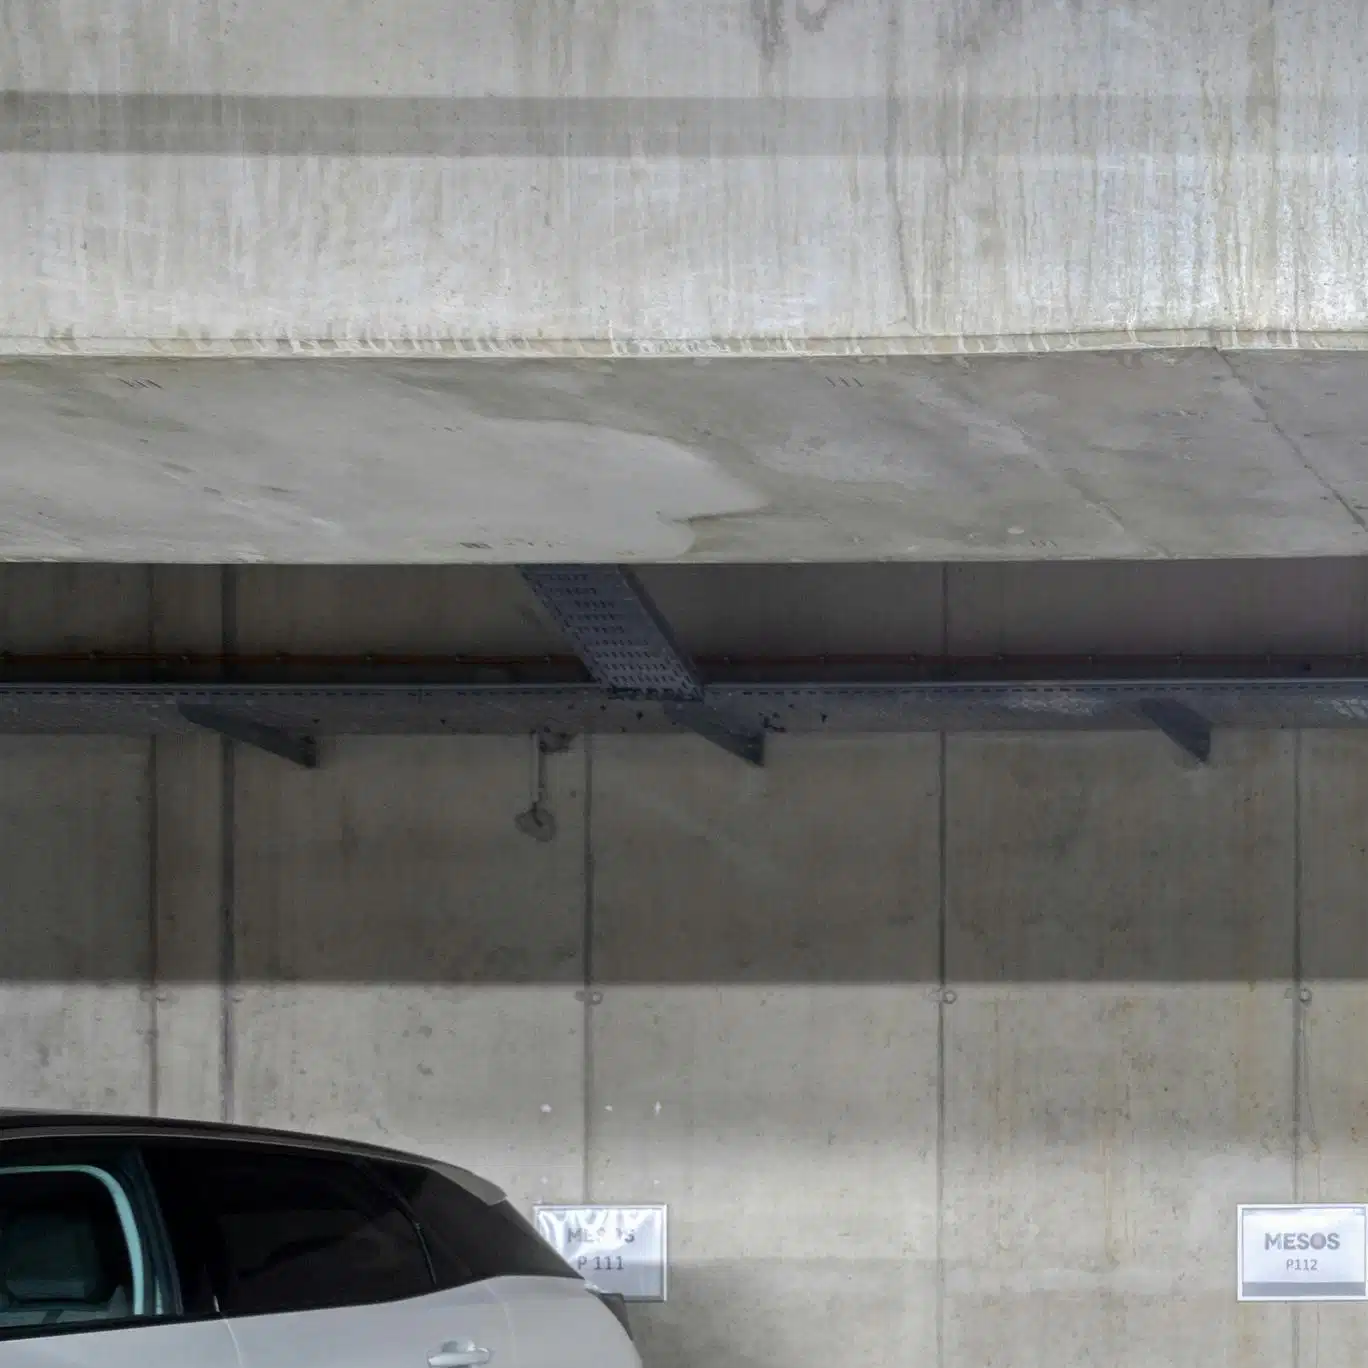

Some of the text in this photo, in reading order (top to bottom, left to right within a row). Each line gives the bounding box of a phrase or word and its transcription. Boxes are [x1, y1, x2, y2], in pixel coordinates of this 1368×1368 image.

[567, 1227, 636, 1243] MES
[1264, 1232, 1341, 1250] MESOS
[577, 1255, 625, 1270] P 111
[1286, 1258, 1319, 1271] P112
